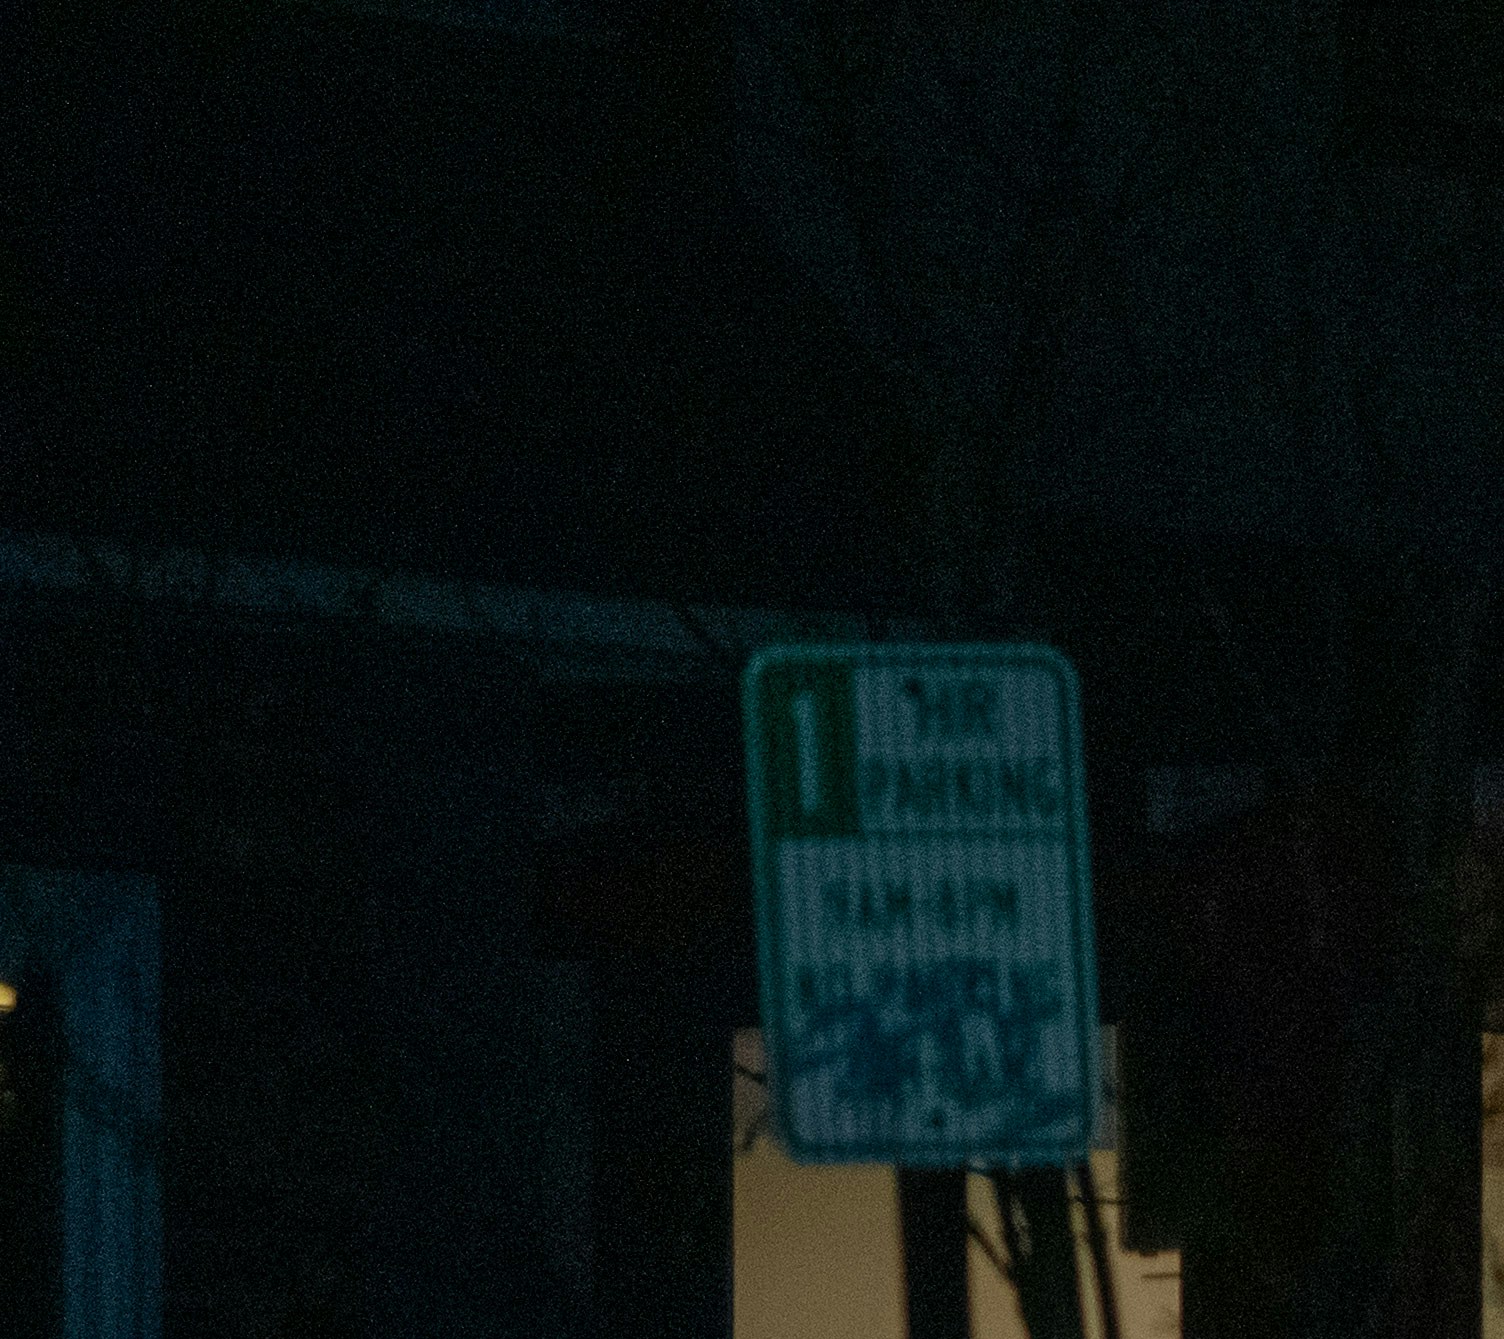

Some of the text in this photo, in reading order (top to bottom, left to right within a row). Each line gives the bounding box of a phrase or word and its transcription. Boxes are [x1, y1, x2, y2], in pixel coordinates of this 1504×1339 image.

[918, 680, 998, 738] HR
[792, 694, 819, 813] 1
[865, 757, 1061, 819] PARKING
